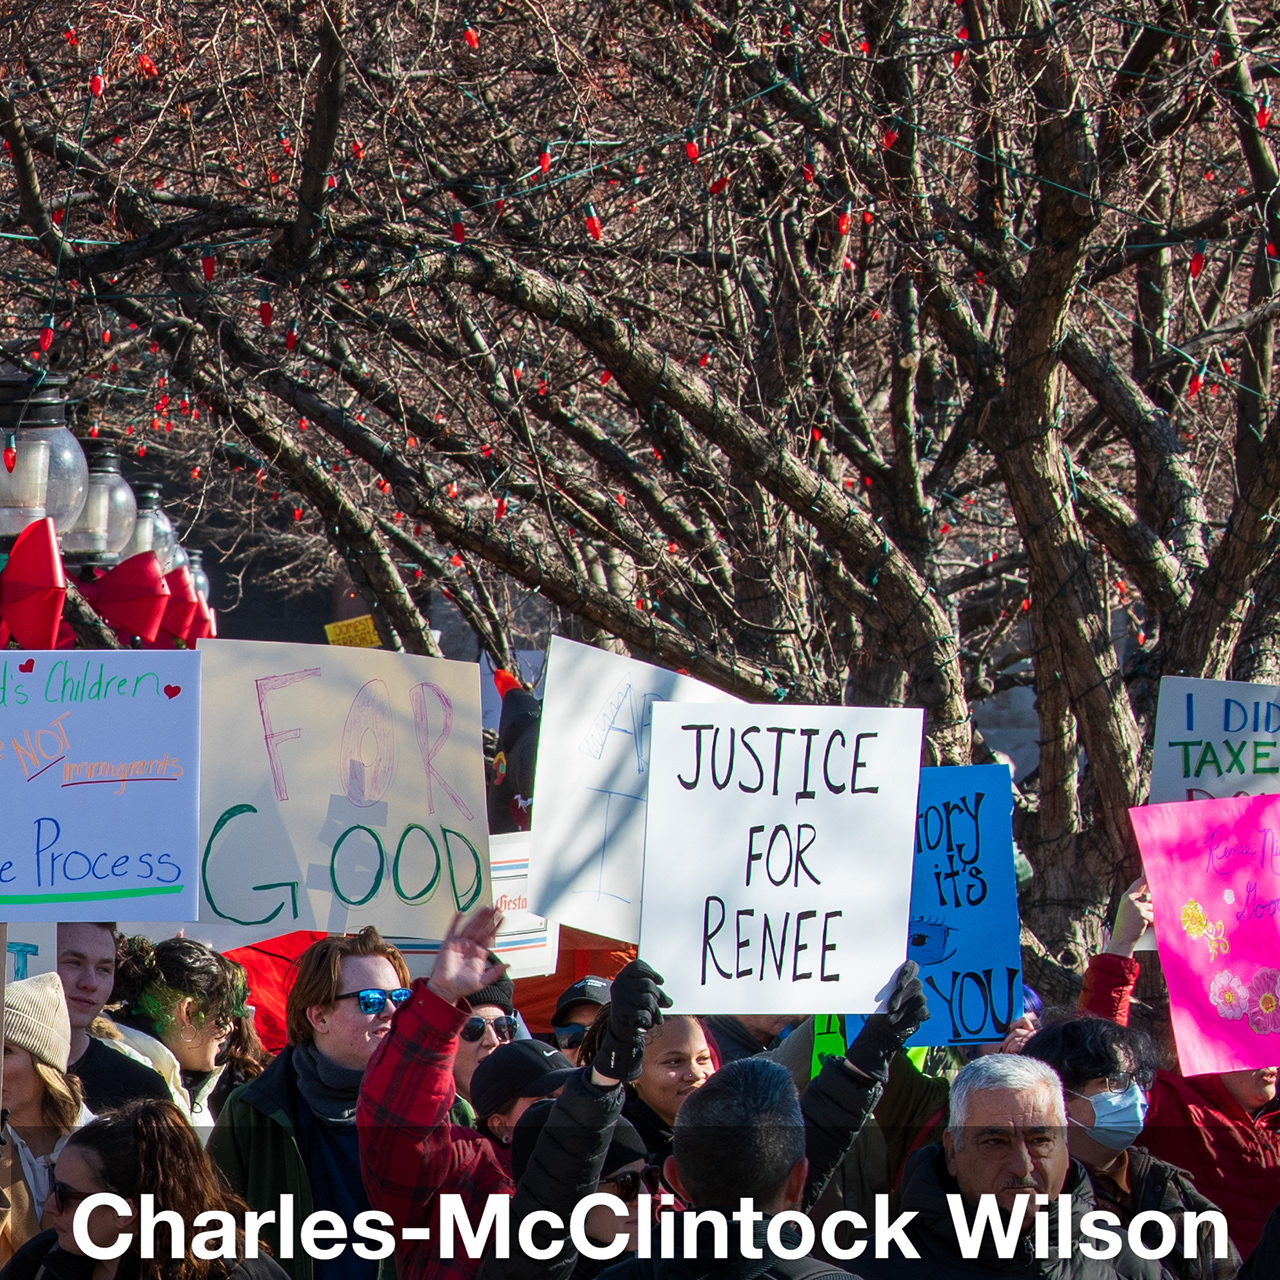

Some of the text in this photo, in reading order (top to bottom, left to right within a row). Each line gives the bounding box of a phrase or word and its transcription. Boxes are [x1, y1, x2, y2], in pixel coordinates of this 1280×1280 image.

[44, 659, 161, 704] Children
[1187, 692, 1194, 732] I
[12, 711, 71, 778] NOT
[255, 667, 474, 821] FOR
[677, 724, 880, 806] JUSTICE
[1168, 739, 1280, 779] TAXE
[33, 817, 183, 888] Process
[201, 803, 483, 926] GOOD
[745, 823, 821, 888] FOR
[496, 893, 528, 913] Gesta
[701, 895, 843, 986] RENEE
[924, 966, 1020, 1039] YOU
